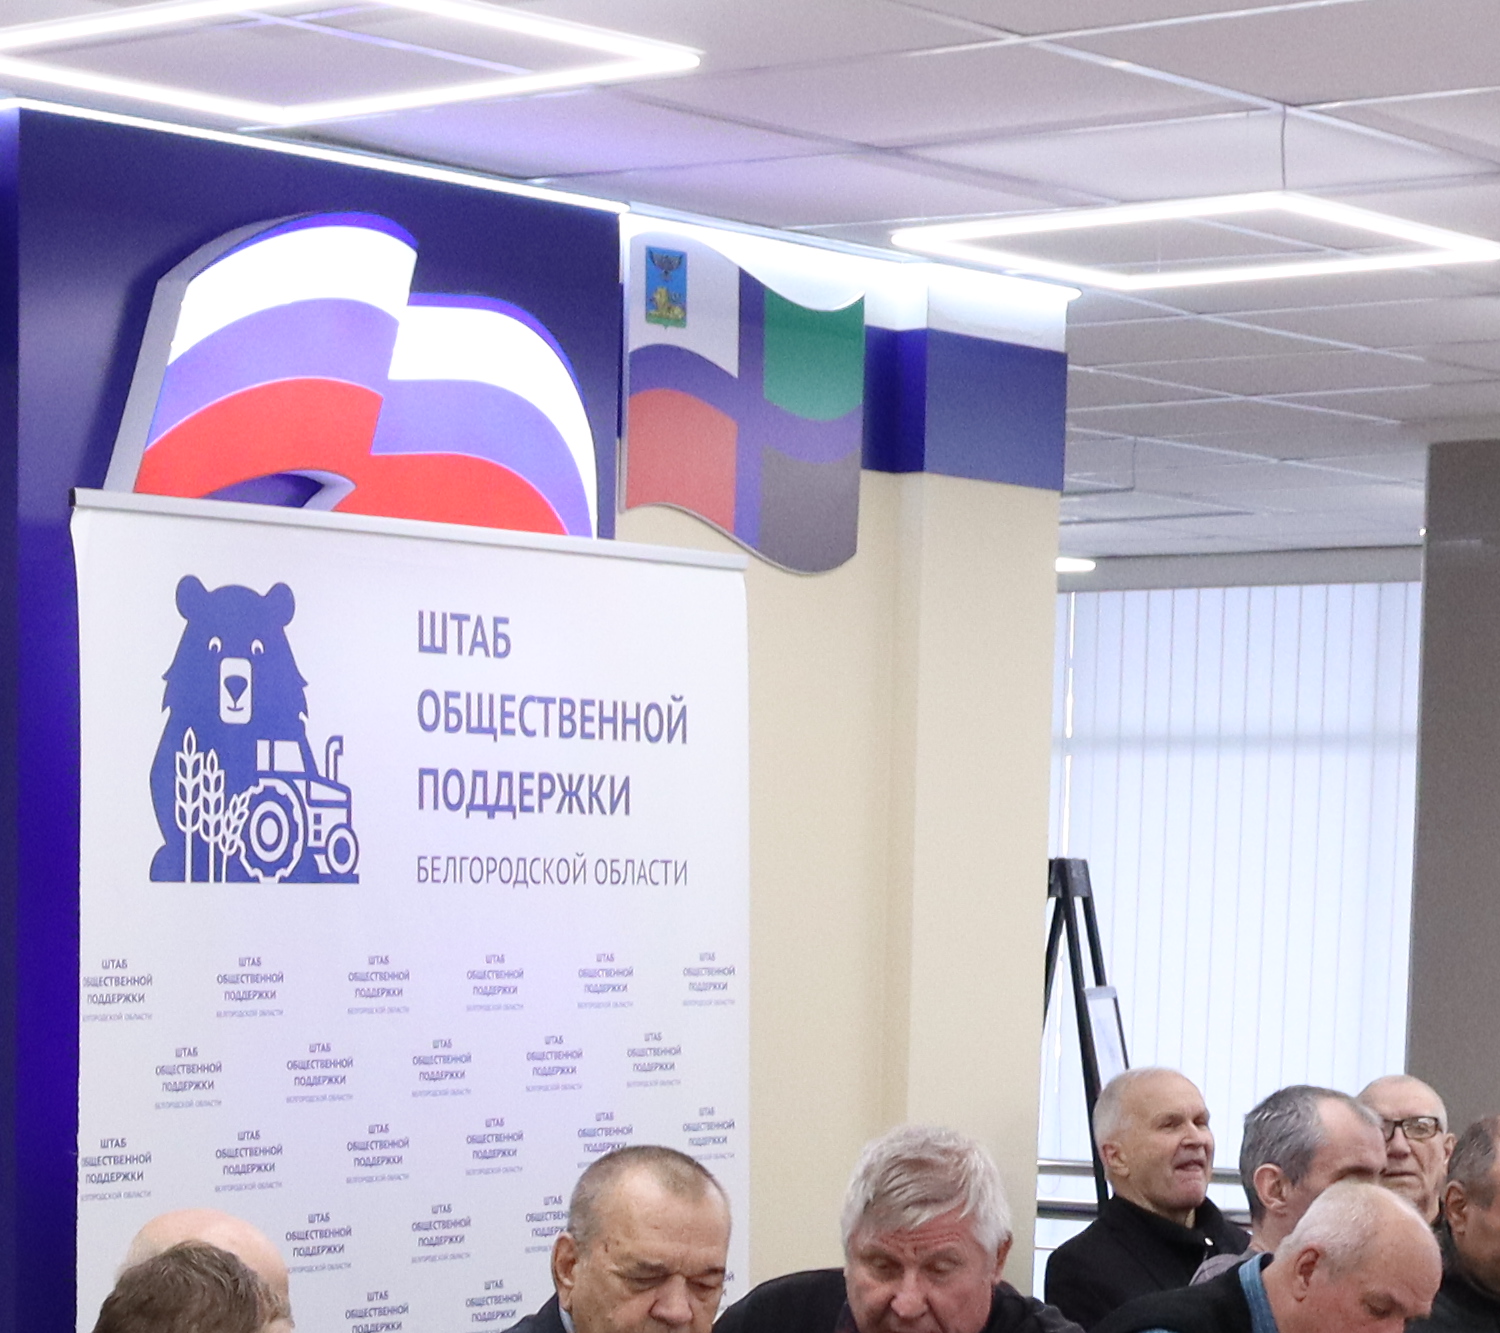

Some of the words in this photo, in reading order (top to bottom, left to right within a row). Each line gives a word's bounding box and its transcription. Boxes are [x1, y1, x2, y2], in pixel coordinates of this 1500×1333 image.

[417, 609, 512, 660] ШТАБ
[417, 688, 688, 745] ОБЩЕСТВЕННОЙ
[418, 767, 631, 820] ПОДДЕРЖКИ
[416, 852, 587, 889] БЕЛГОРОДСКОЙ
[594, 857, 689, 886] ОБЛАСТИ
[101, 958, 128, 970] ШТАБ
[239, 956, 262, 968] ШТАБ
[216, 971, 284, 985] ОБЩЕСТВЕННОЙ
[86, 992, 146, 1006] ПОДДЕРЖКИ
[224, 989, 277, 1002] ПОДДЕРЖКИ
[174, 1046, 199, 1058] ШТАБ
[154, 1061, 223, 1077] ОБЩЕСТВЕННОЙ
[286, 1057, 354, 1072] ОБЩЕСТВЕННОЙ
[161, 1079, 216, 1094] ПОДДЕРЖКИ
[293, 1074, 347, 1088] ПОДДЕРЖКИ
[237, 1129, 262, 1142] ШТАБ
[100, 1137, 128, 1150] ШТАБ
[215, 1144, 284, 1160] ОБЩЕСТВЕННОЙ
[222, 1162, 276, 1176] ПОДДЕРЖКИ
[85, 1170, 144, 1185] ПОДДЕРЖКИ
[308, 1211, 331, 1224] ШТАБ
[285, 1225, 352, 1242] ОБЩЕСТВЕННОЙ
[292, 1244, 346, 1258] ПОДДЕРЖКИ
[345, 1303, 409, 1320] ОБЩЕСТВЕННОЙ
